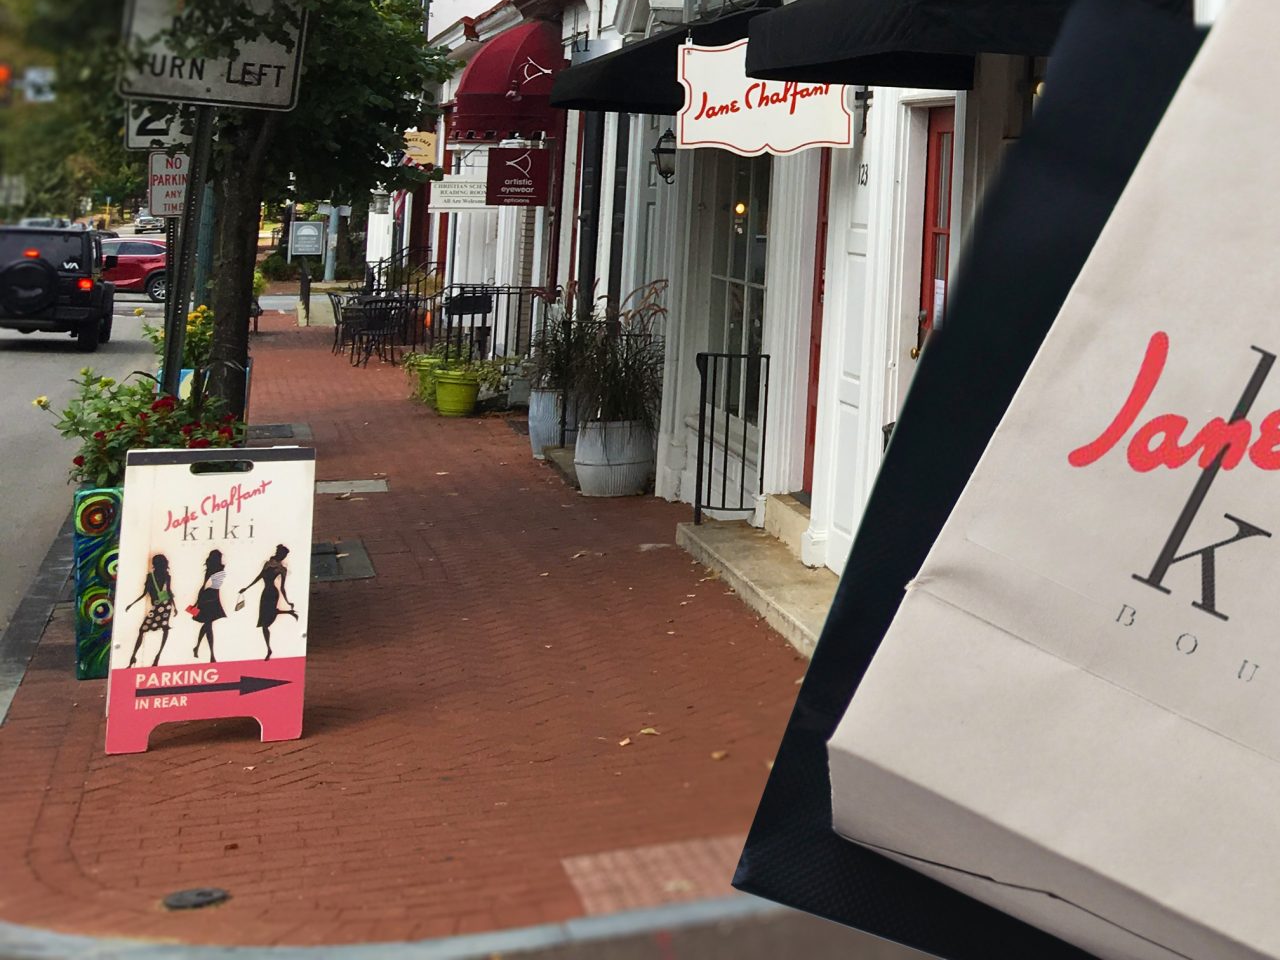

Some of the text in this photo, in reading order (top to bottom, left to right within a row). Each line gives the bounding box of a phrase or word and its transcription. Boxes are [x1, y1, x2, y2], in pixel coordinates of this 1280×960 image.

[226, 60, 286, 87] LEFT
[694, 91, 741, 120] Jane
[166, 158, 182, 169] NO
[151, 174, 189, 186] PARKIN
[857, 163, 869, 187] 123
[165, 190, 182, 198] ANY
[500, 186, 534, 194] eyewear
[163, 480, 272, 532] Jane Chalfant
[182, 505, 255, 541] kiki
[135, 668, 219, 688] PARKING
[134, 695, 187, 710] IN REAR
